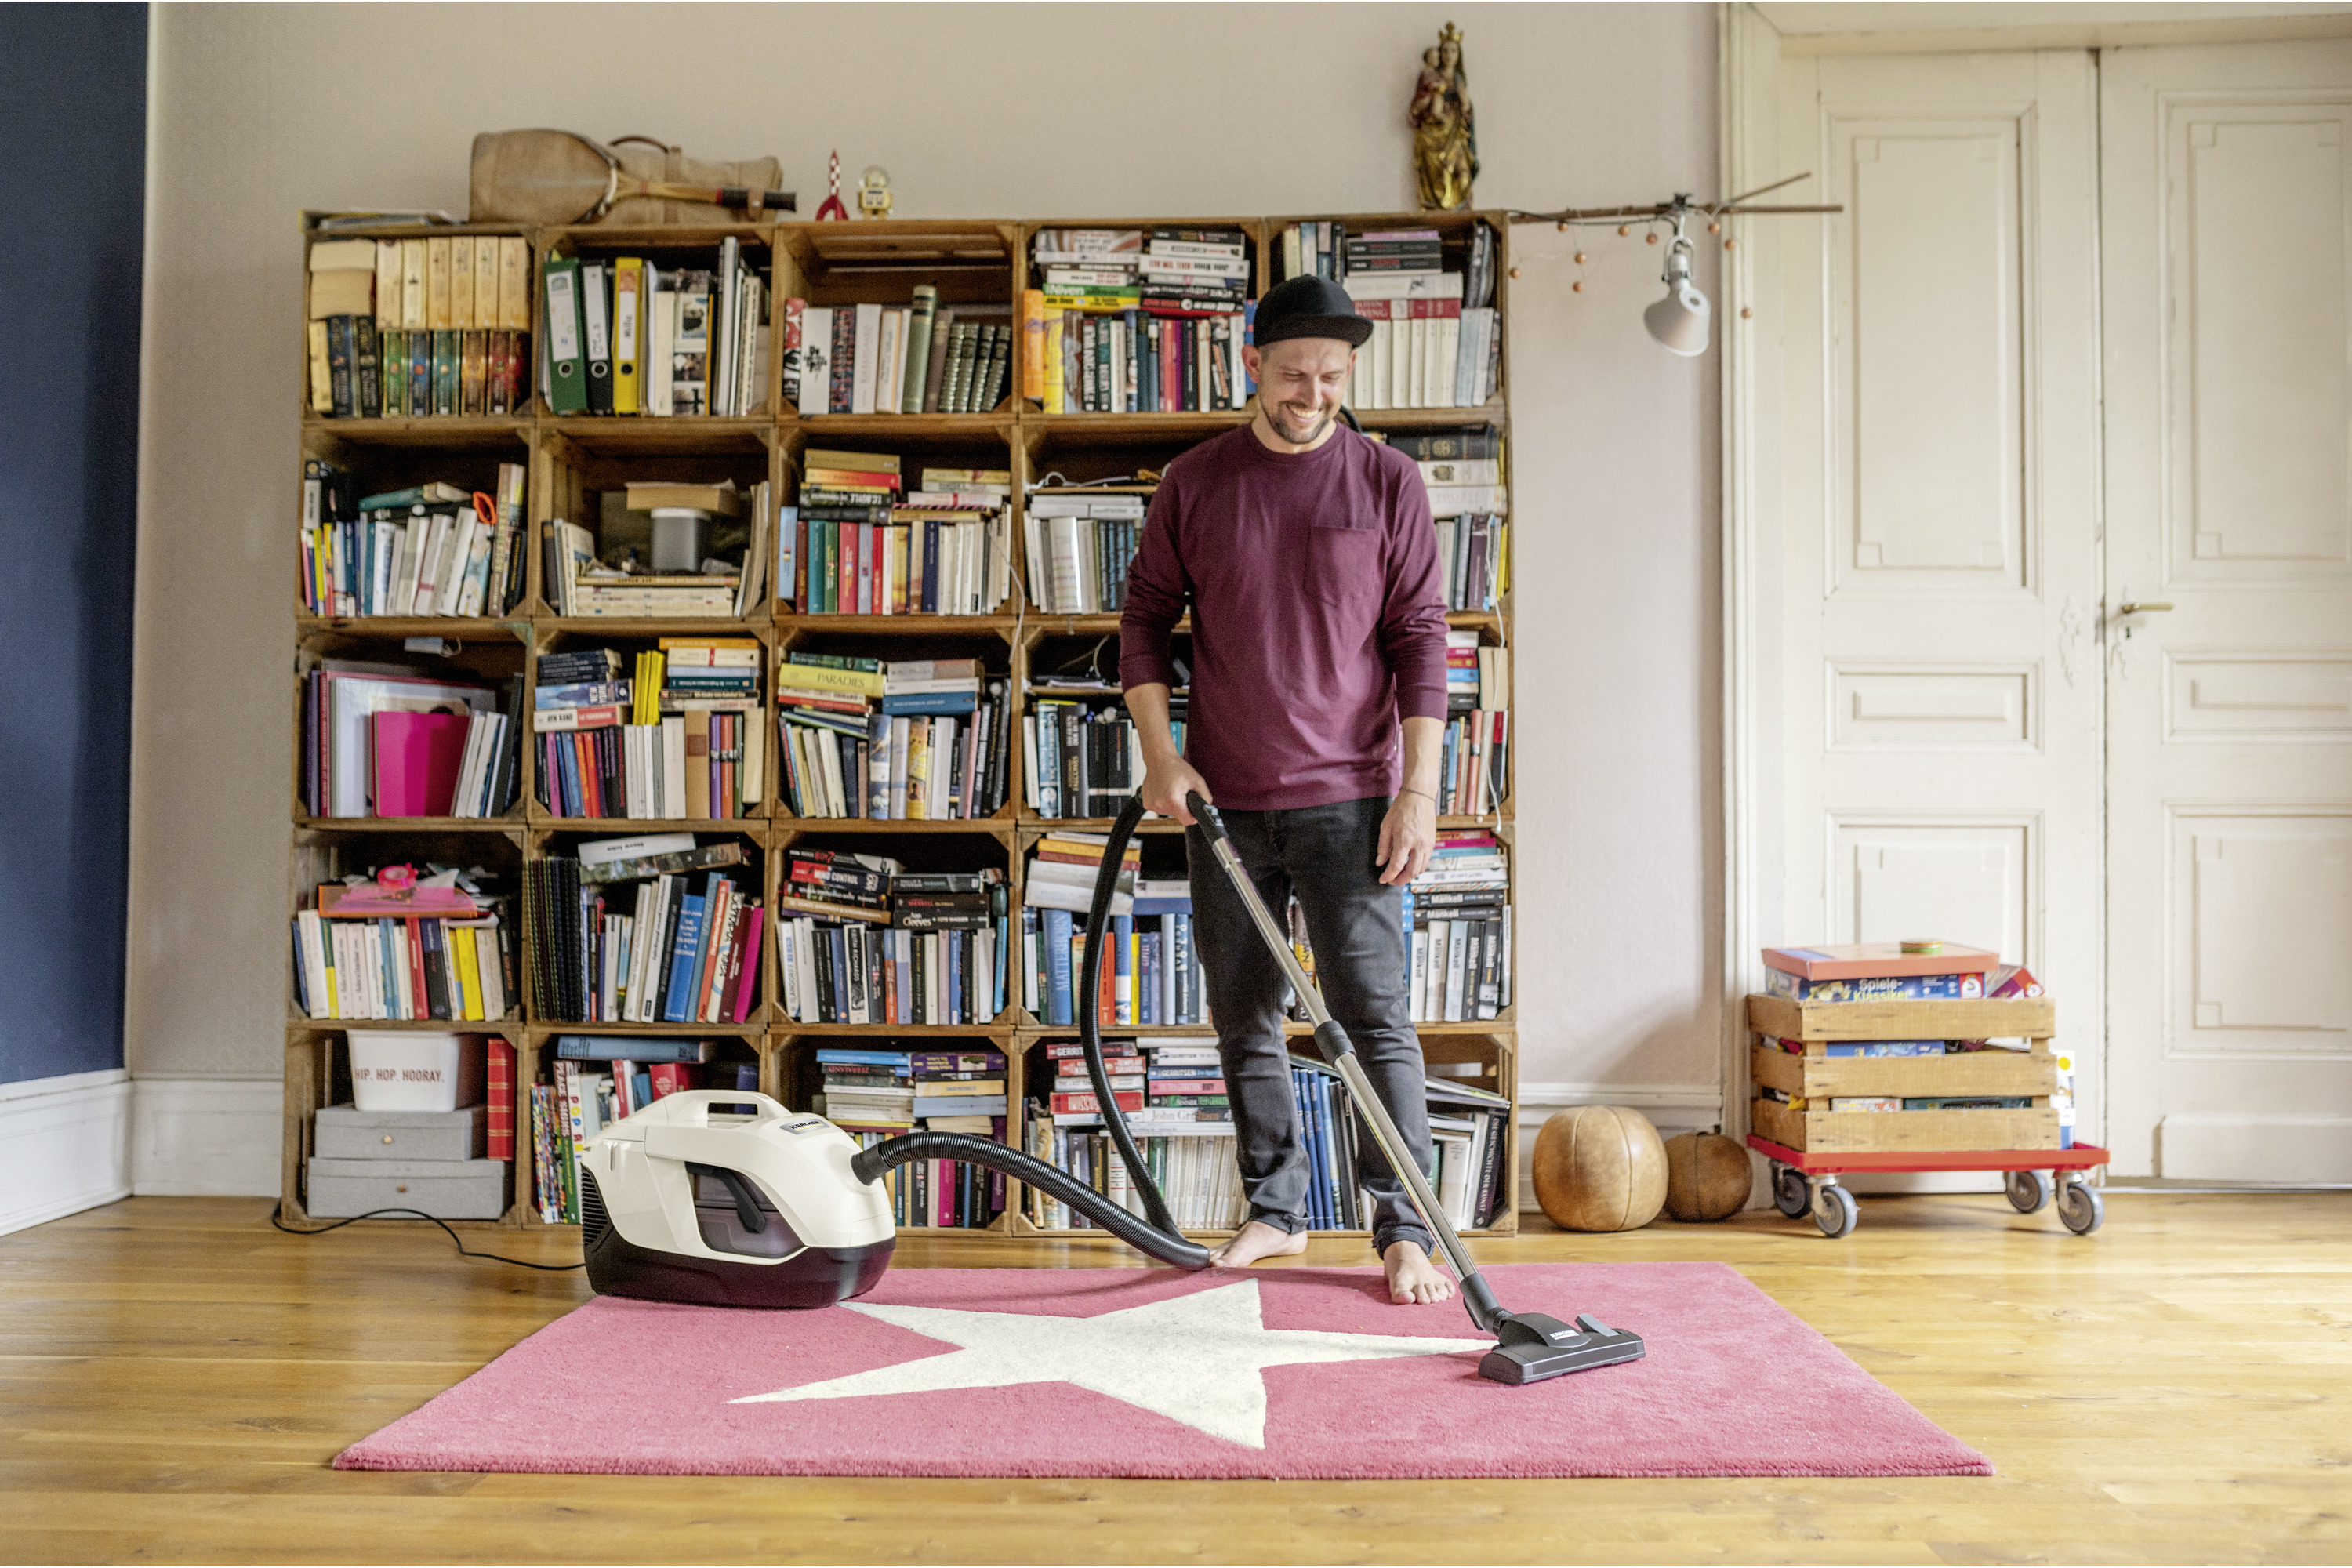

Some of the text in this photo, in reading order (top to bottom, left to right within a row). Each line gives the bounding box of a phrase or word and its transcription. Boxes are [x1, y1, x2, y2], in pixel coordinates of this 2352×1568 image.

[816, 672, 865, 688] PARADIES
[832, 871, 858, 885] CONTROL
[1431, 893, 1463, 903] Mankell
[1427, 908, 1459, 919] Mankell
[851, 928, 862, 982] KEITH RICHARDS
[1052, 913, 1071, 991] MATTERHORN
[1415, 947, 1425, 978] Mankell
[1433, 938, 1443, 970] Mankell
[1452, 938, 1462, 969] Mankell
[1468, 936, 1479, 969] Mankell
[1486, 935, 1497, 968] Mankell
[1858, 978, 1903, 993] Spiele-
[354, 1068, 445, 1083] HIP. HOP. HOORAY.
[1162, 1069, 1196, 1077] GERRITSEN
[554, 1061, 571, 1137] PEACE SIGNS
[570, 1095, 583, 1127] POP
[789, 1120, 822, 1130] KÄRCHER
[1152, 1109, 1220, 1121] John Grisham
[1485, 1129, 1498, 1173] GESCHICHTE
[1477, 1189, 1489, 1214] KUNST
